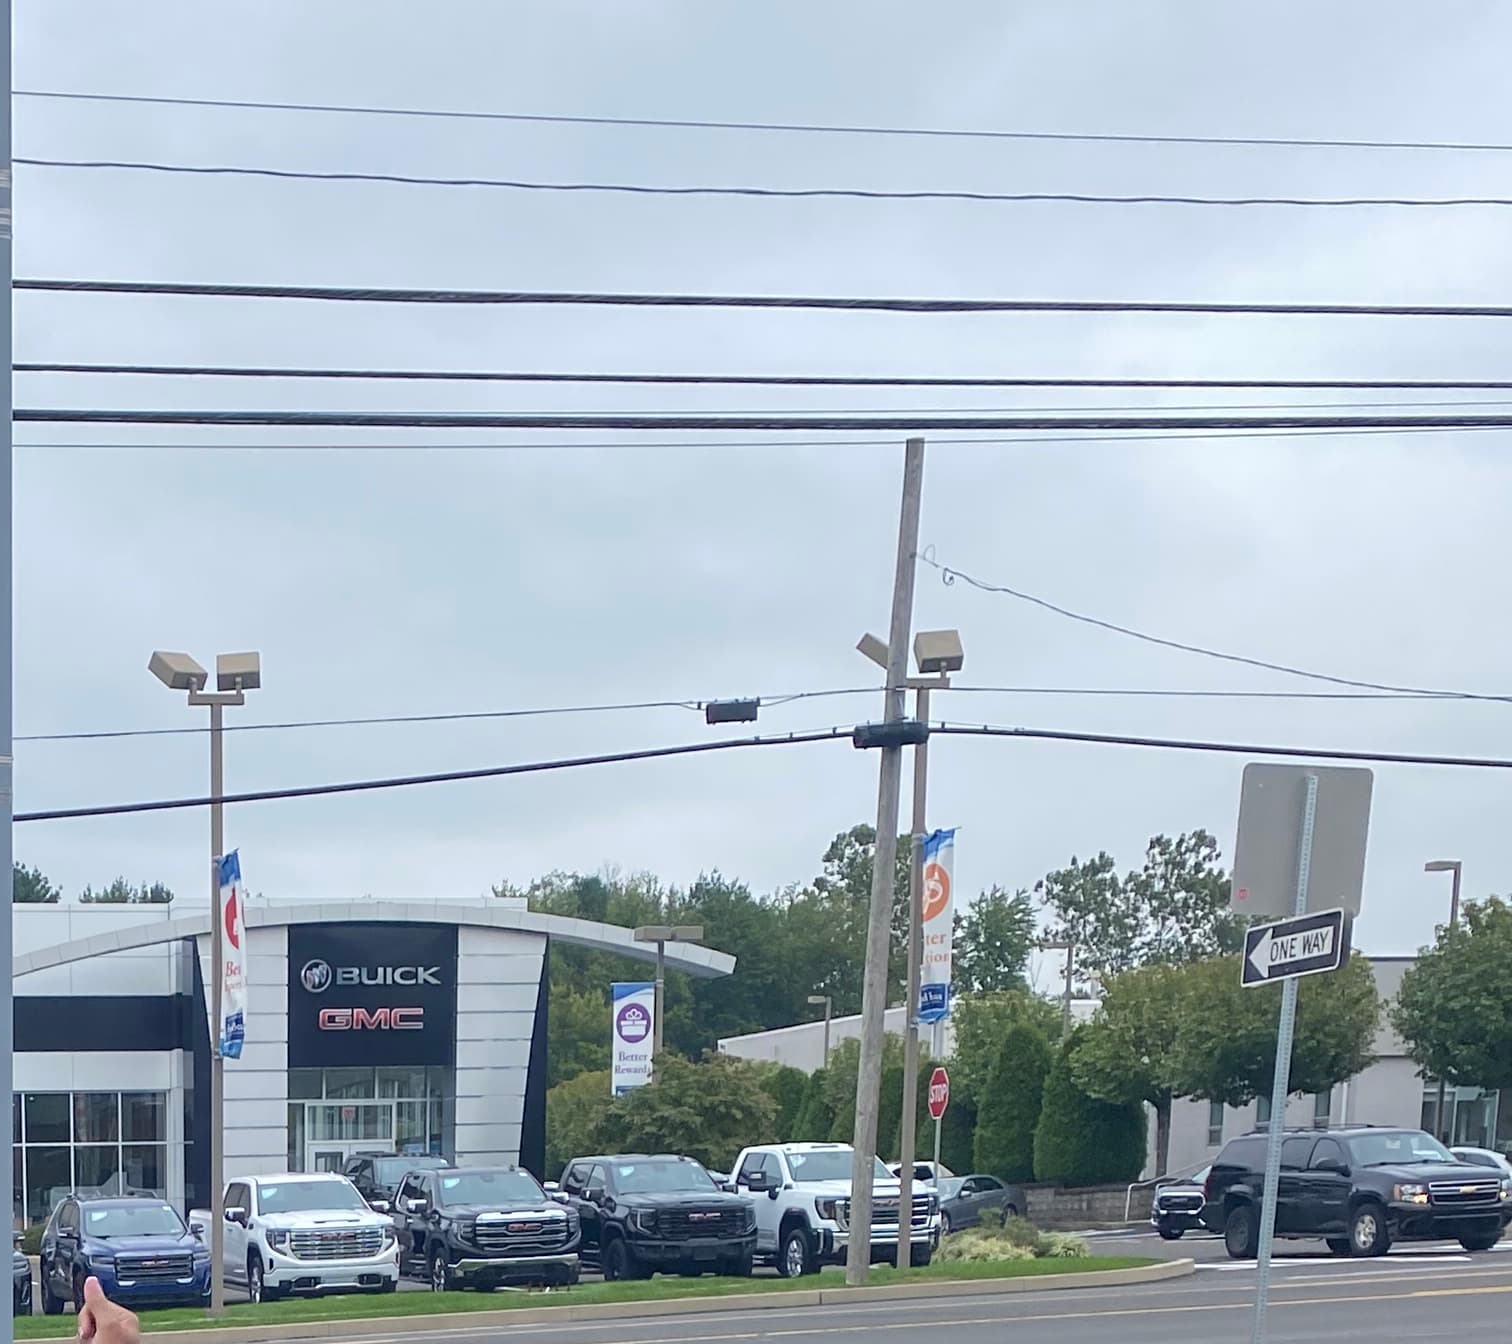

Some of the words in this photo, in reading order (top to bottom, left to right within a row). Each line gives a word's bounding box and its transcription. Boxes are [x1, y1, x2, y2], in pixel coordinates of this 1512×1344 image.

[1270, 938, 1297, 962] ONE
[1303, 931, 1329, 956] WAY
[336, 966, 441, 985] BUICK
[319, 1007, 424, 1030] GMC
[619, 1051, 648, 1061] Better
[929, 1083, 947, 1104] STOP
